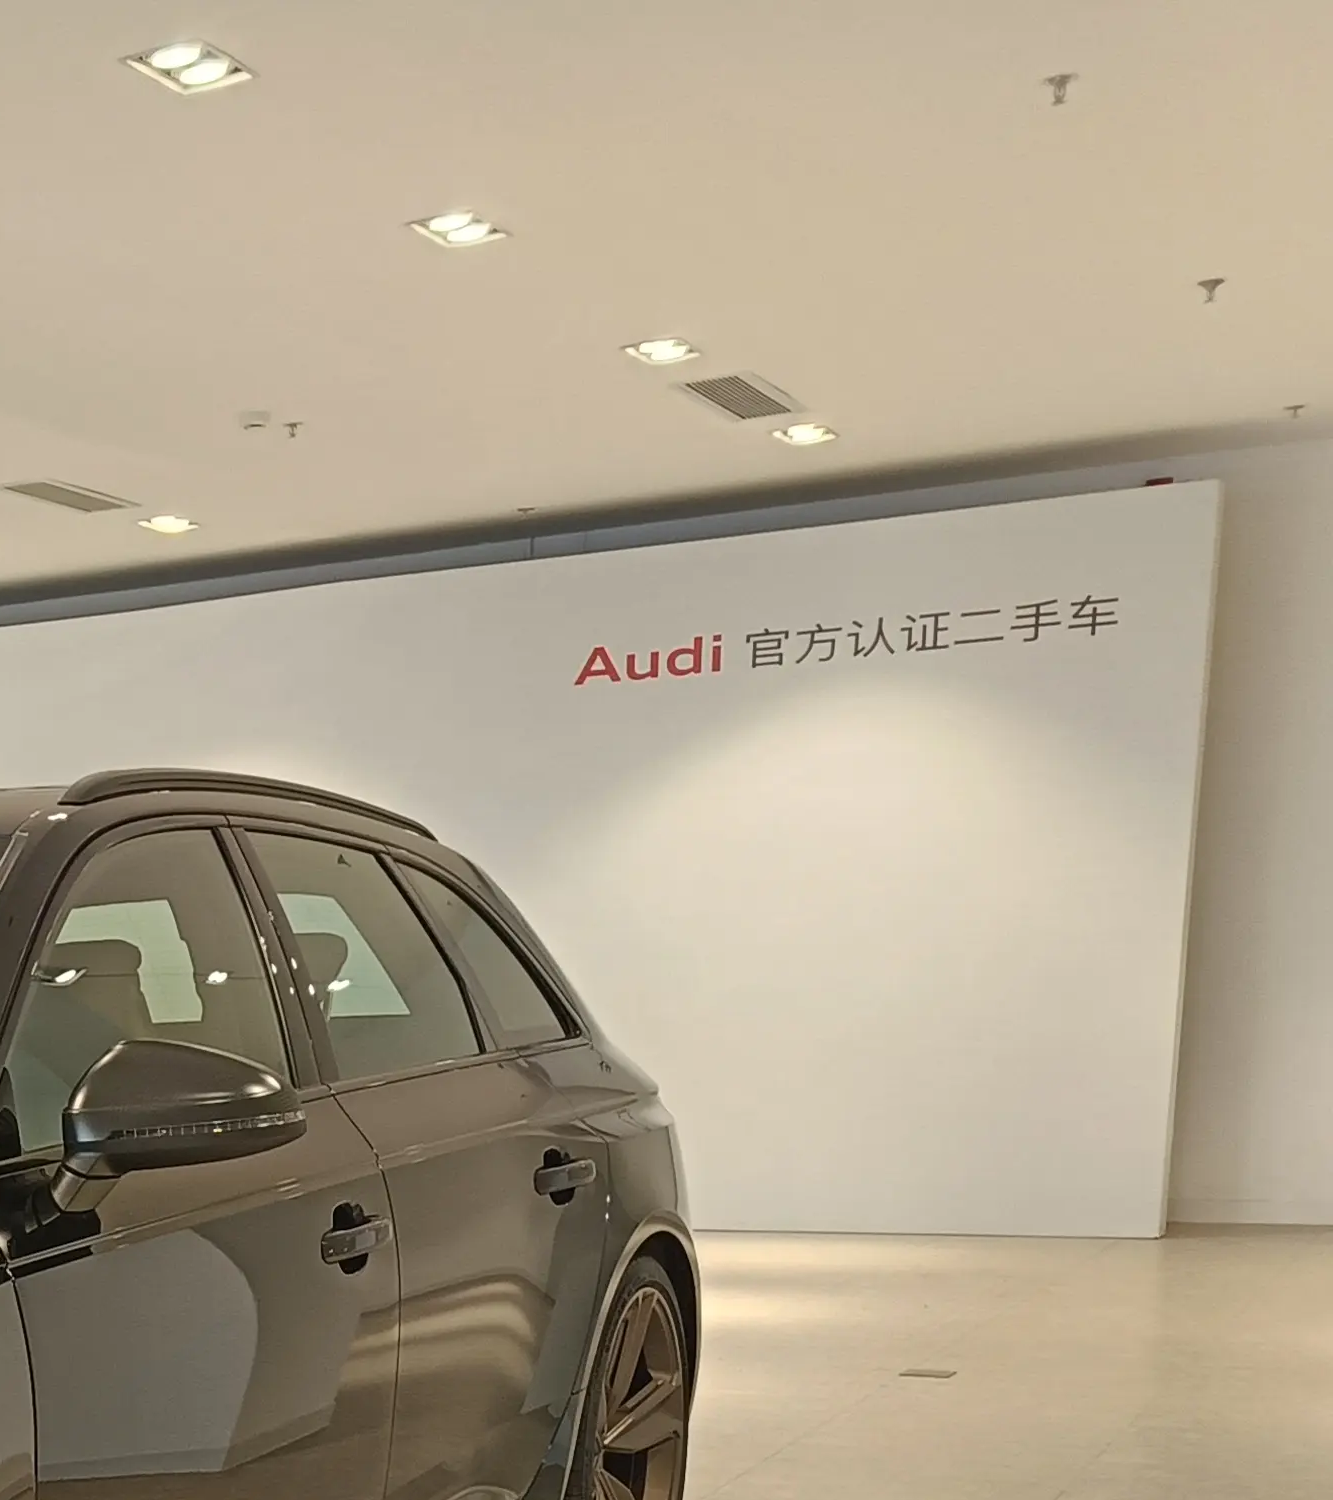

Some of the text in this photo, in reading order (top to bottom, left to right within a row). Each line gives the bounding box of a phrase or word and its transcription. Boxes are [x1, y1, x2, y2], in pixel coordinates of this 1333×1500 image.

[573, 593, 1120, 685] Audi 官方认证二手车
